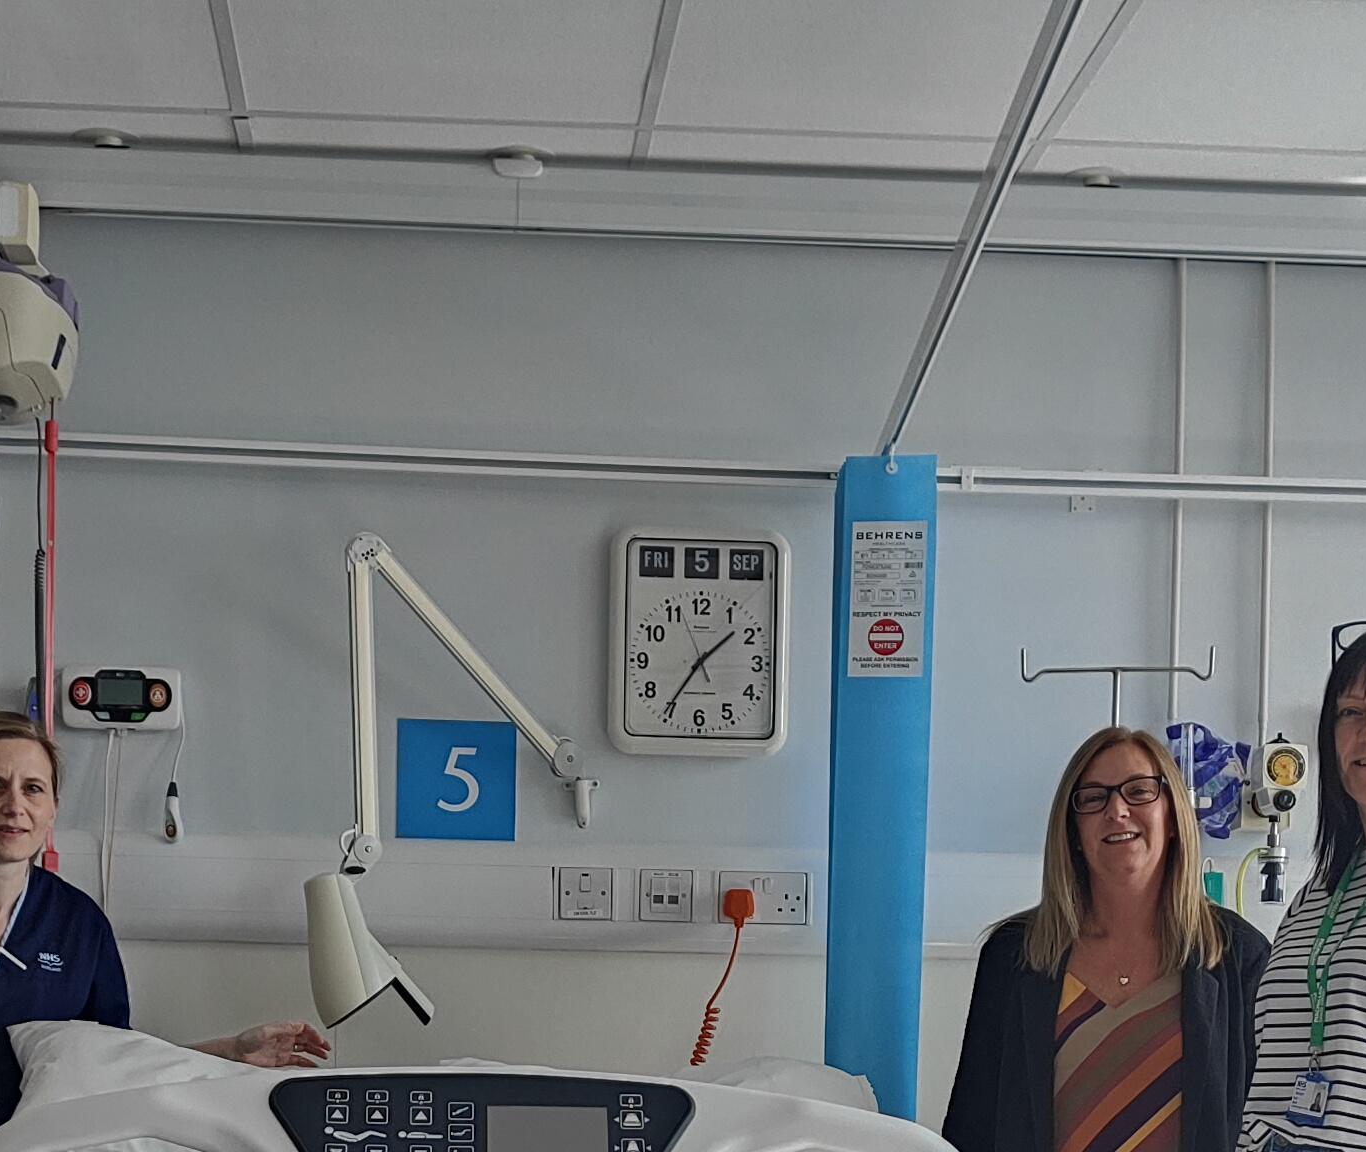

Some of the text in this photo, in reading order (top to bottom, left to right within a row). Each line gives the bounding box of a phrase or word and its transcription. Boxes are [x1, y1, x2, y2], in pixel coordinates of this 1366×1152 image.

[856, 531, 923, 540] BEHRENS
[644, 550, 759, 572] FRI 5 SEP
[665, 605, 681, 623] 11
[692, 598, 711, 616] 12
[726, 607, 733, 624] 1
[645, 625, 665, 642] 10
[743, 628, 755, 645] 2
[637, 652, 649, 669] 9
[751, 655, 763, 673] 3
[644, 681, 657, 698] 8
[742, 683, 755, 701] 4
[665, 702, 677, 719] 7
[693, 709, 705, 727] 6
[721, 703, 733, 720] 5
[436, 746, 480, 812] 5
[38, 952, 61, 963] NHS
